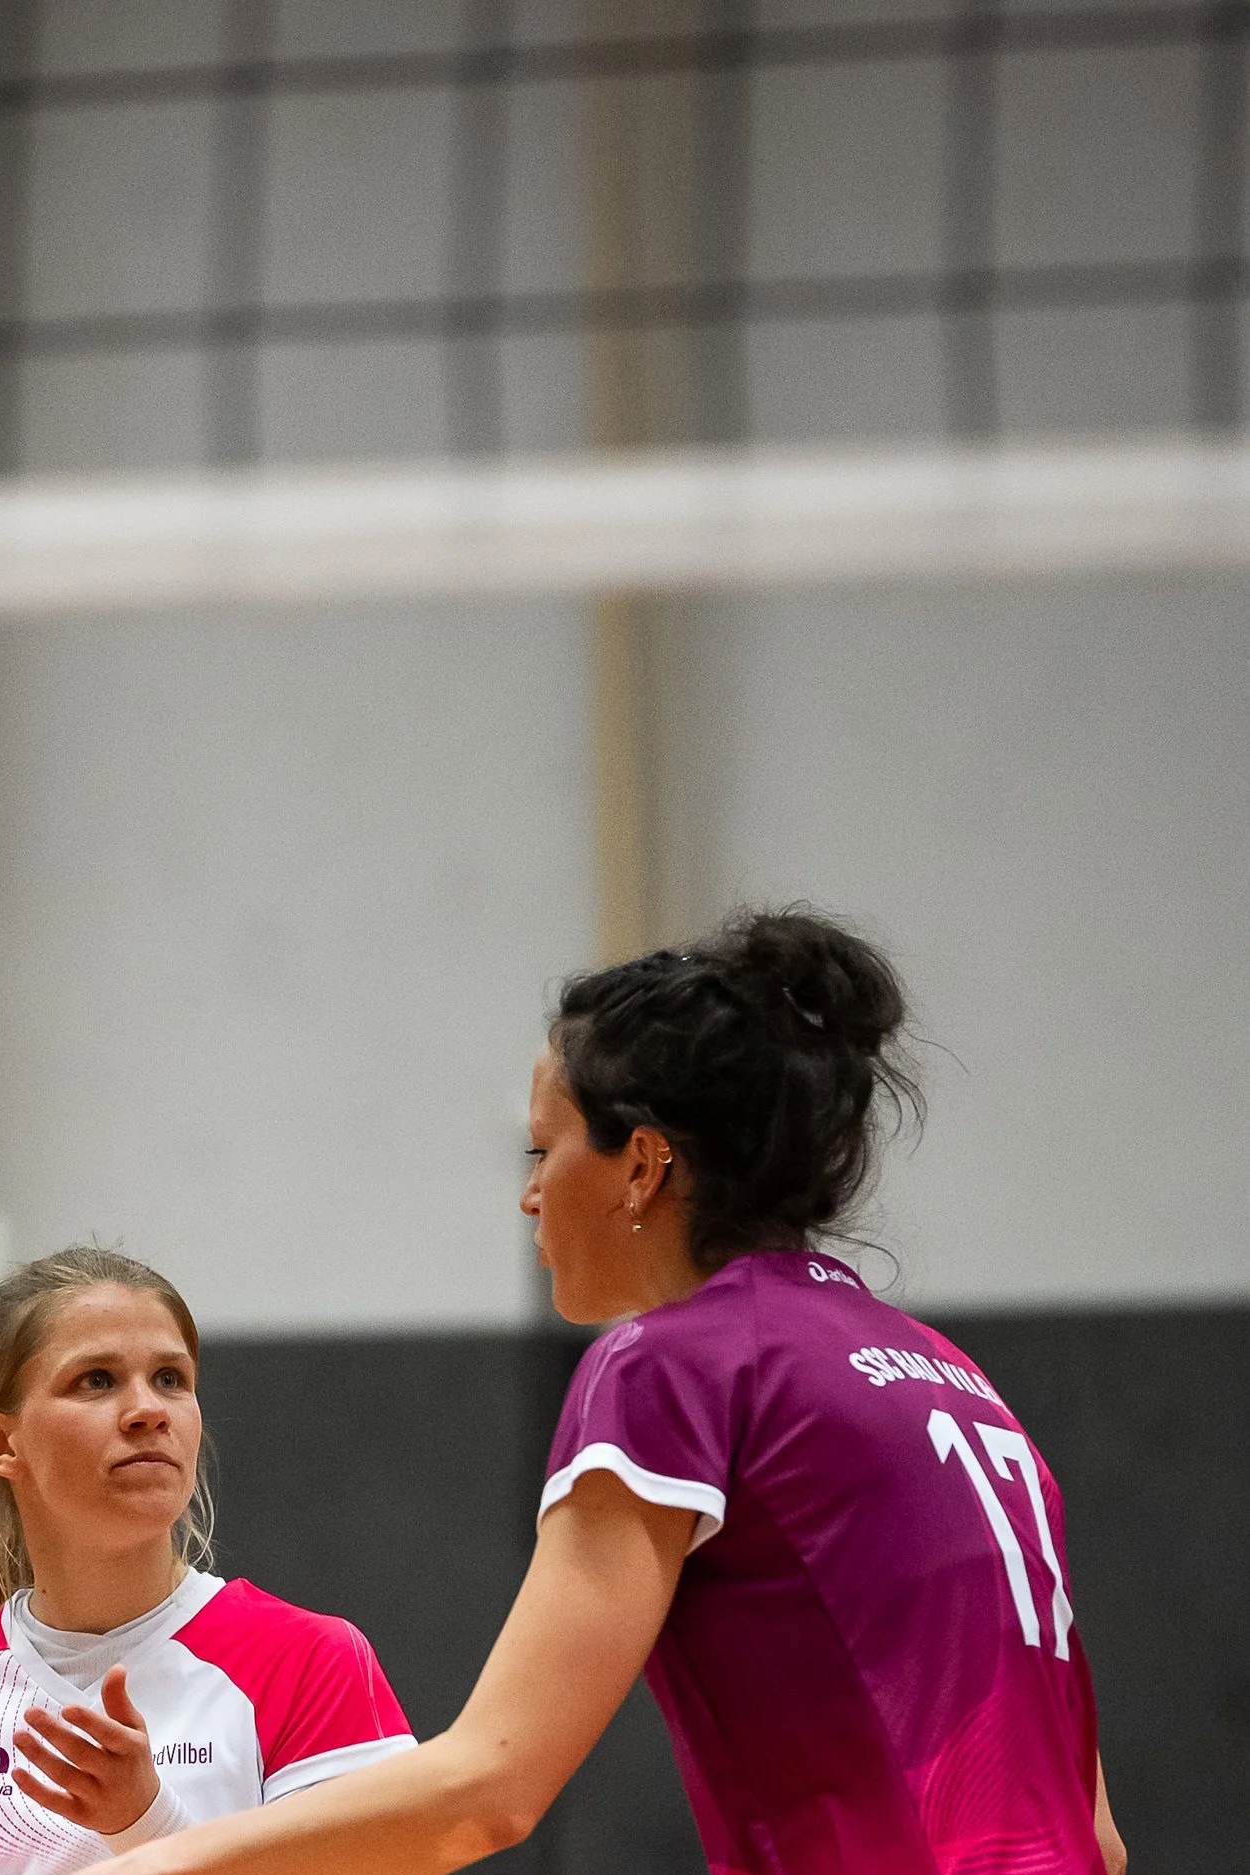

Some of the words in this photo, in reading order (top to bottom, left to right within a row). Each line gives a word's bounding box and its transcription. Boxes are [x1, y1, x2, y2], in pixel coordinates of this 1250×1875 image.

[849, 1347, 905, 1387] SSC
[884, 1347, 945, 1385] BAD
[927, 1408, 1074, 1662] 17
